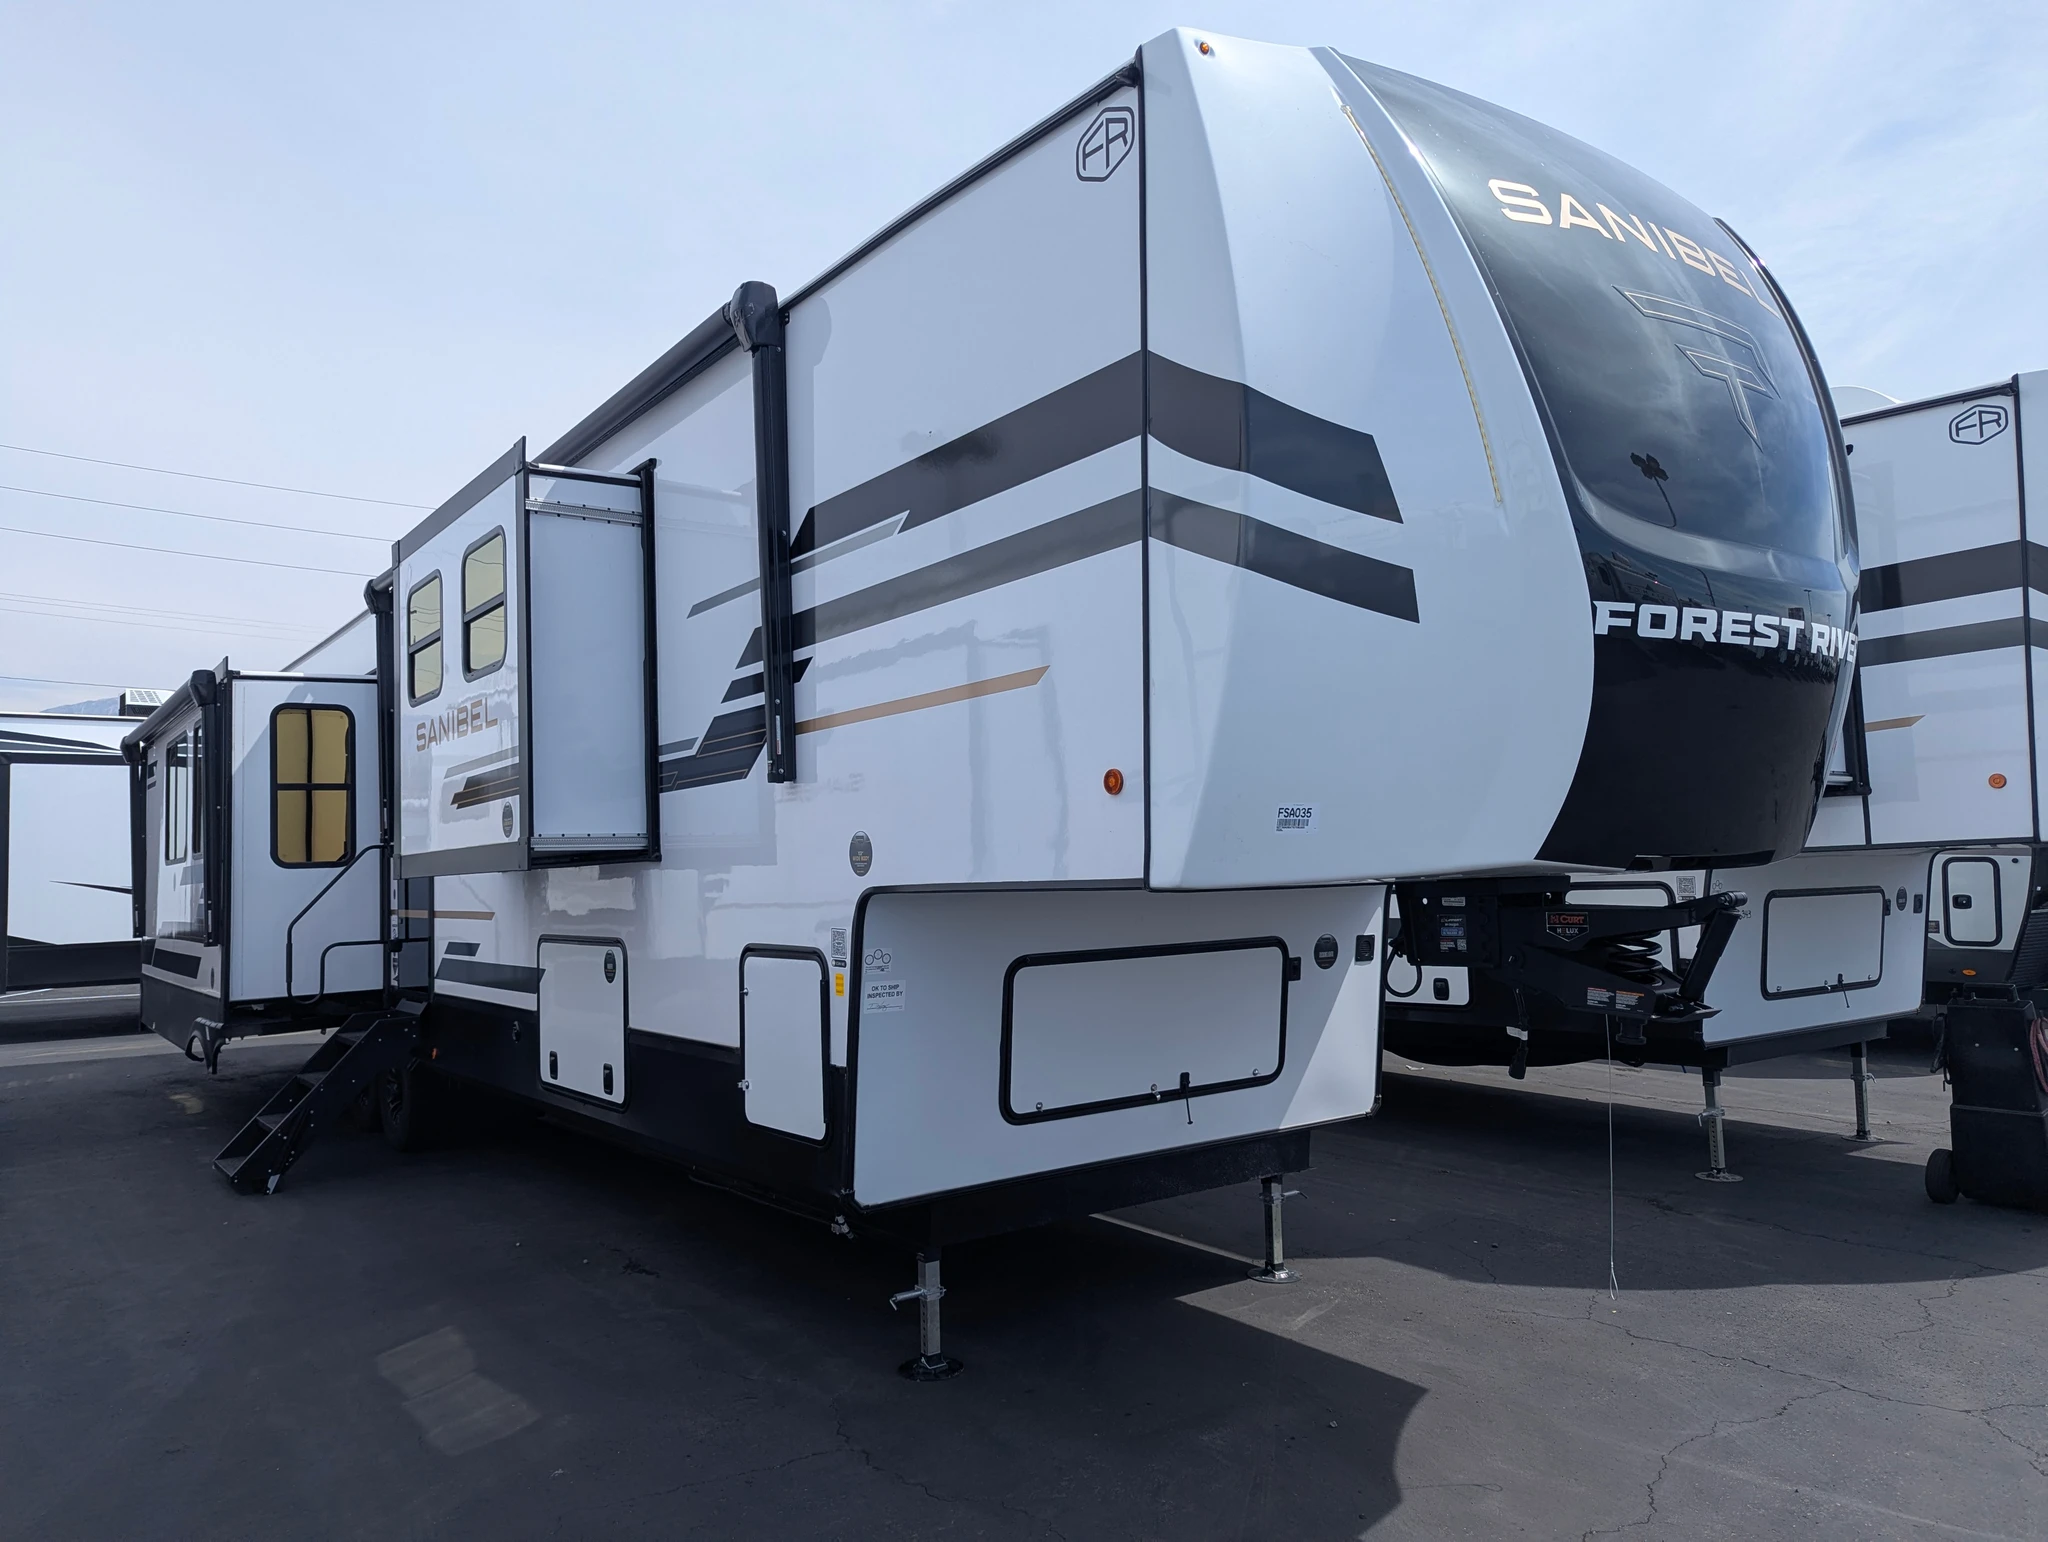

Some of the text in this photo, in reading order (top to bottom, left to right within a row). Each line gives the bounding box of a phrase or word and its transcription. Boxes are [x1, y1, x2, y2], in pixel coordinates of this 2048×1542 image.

[1487, 179, 1782, 321] SANIBEL
[1593, 600, 1857, 664] FOREST RIVE
[416, 697, 498, 752] SANIBEL
[1277, 807, 1313, 819] FSA035
[1559, 914, 1585, 924] CURT
[866, 991, 895, 999] INSPECTED
